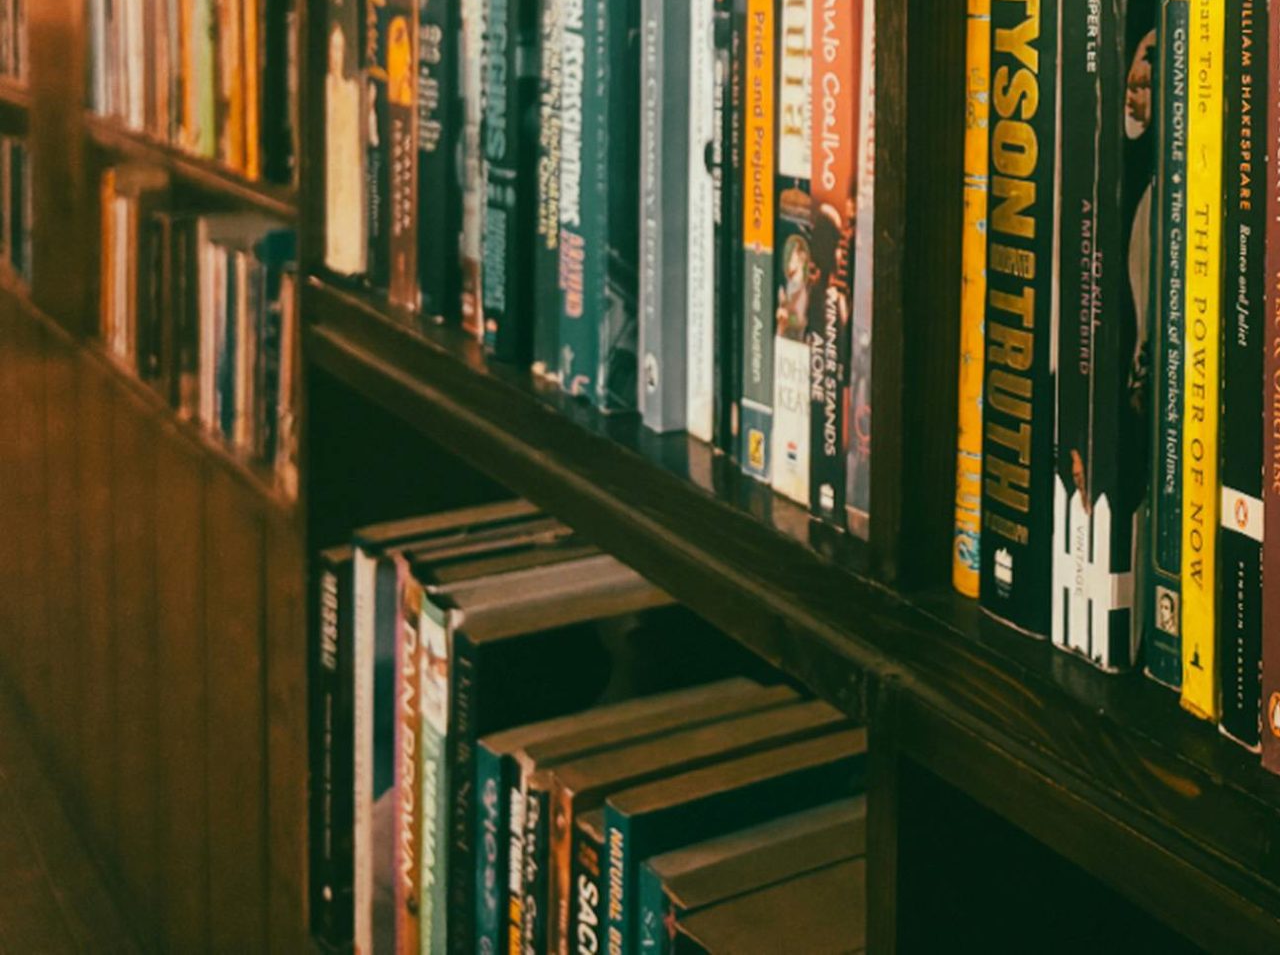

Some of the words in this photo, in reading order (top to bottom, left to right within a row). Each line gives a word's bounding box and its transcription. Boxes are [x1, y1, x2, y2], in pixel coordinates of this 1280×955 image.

[751, 10, 767, 71] Pride
[1086, 44, 1098, 73] LEE
[1173, 27, 1187, 96] CONAN
[751, 80, 766, 120] and
[1198, 51, 1216, 114] Tolle
[818, 71, 842, 192] Coelho
[1172, 101, 1185, 162] DOYLE
[1238, 74, 1252, 212] SHAKESPEARE
[748, 125, 766, 230] Prejudice
[1080, 199, 1092, 213] A
[1170, 190, 1183, 222] The
[1168, 228, 1182, 324] Case-Book
[1195, 203, 1211, 278] THE
[1236, 224, 1251, 274] Romeo
[1078, 220, 1092, 376] MOCKINGBIRD
[1236, 305, 1251, 348] Juliet
[1237, 276, 1250, 303] and
[811, 330, 825, 403] ALONE
[1166, 348, 1181, 424] Sherlock
[1190, 296, 1207, 424] POWER
[823, 376, 838, 457] STANDS
[987, 286, 1035, 514] TRUTH
[1165, 428, 1179, 495] Holmes
[1189, 437, 1205, 484] OF
[1073, 525, 1085, 599] VINTAGE
[1188, 501, 1205, 592] NOW
[401, 622, 416, 718] DAN
[401, 724, 417, 889] BROWN
[609, 827, 623, 921] NATURAL
